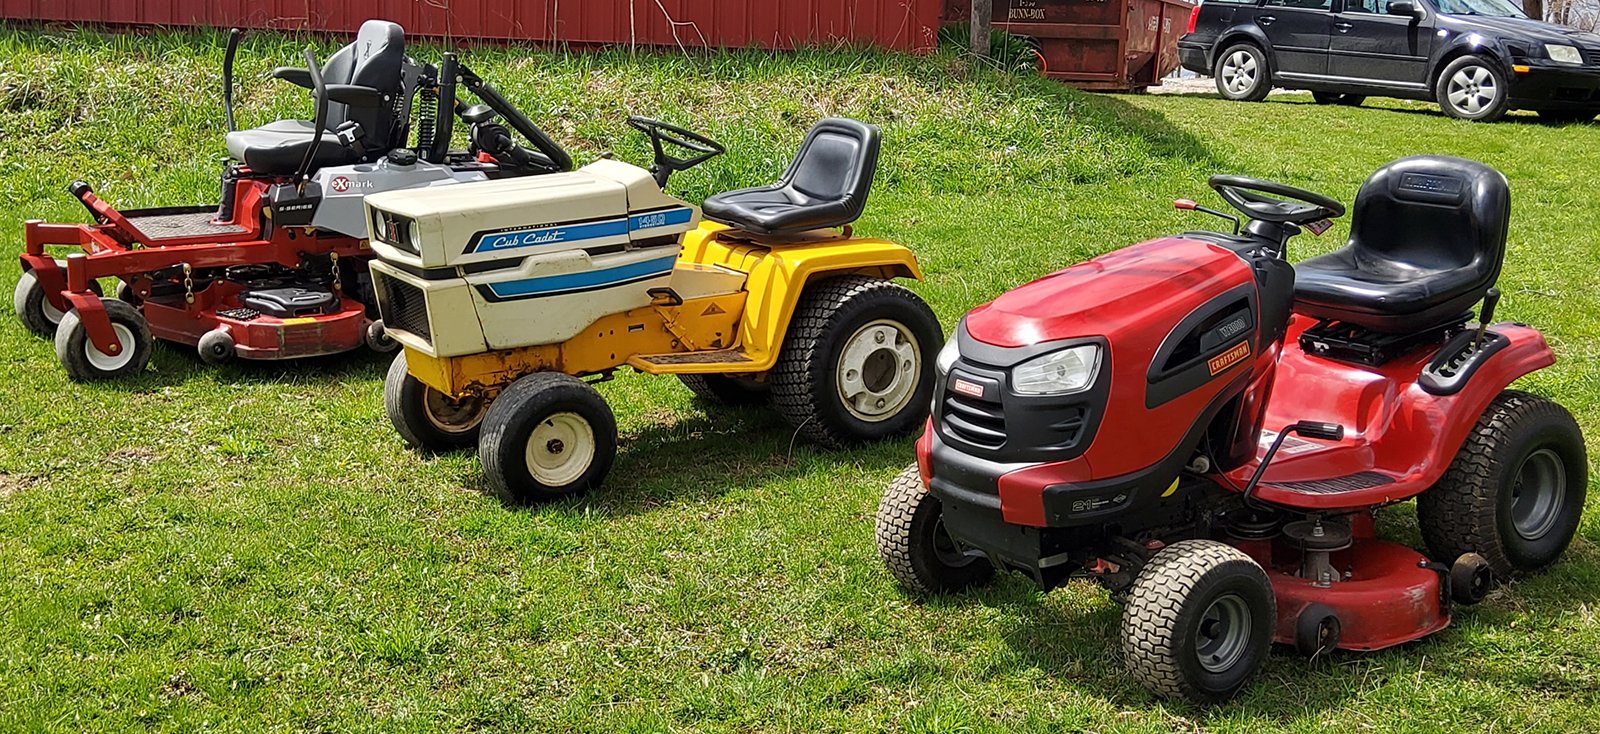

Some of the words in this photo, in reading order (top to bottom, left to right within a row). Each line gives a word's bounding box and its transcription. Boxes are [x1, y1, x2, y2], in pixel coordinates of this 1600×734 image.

[1009, 8, 1046, 19] BUNN-BOX
[493, 235, 519, 248] Cub
[523, 230, 566, 244] Cadet
[1210, 346, 1249, 371] CRAFTSMAN
